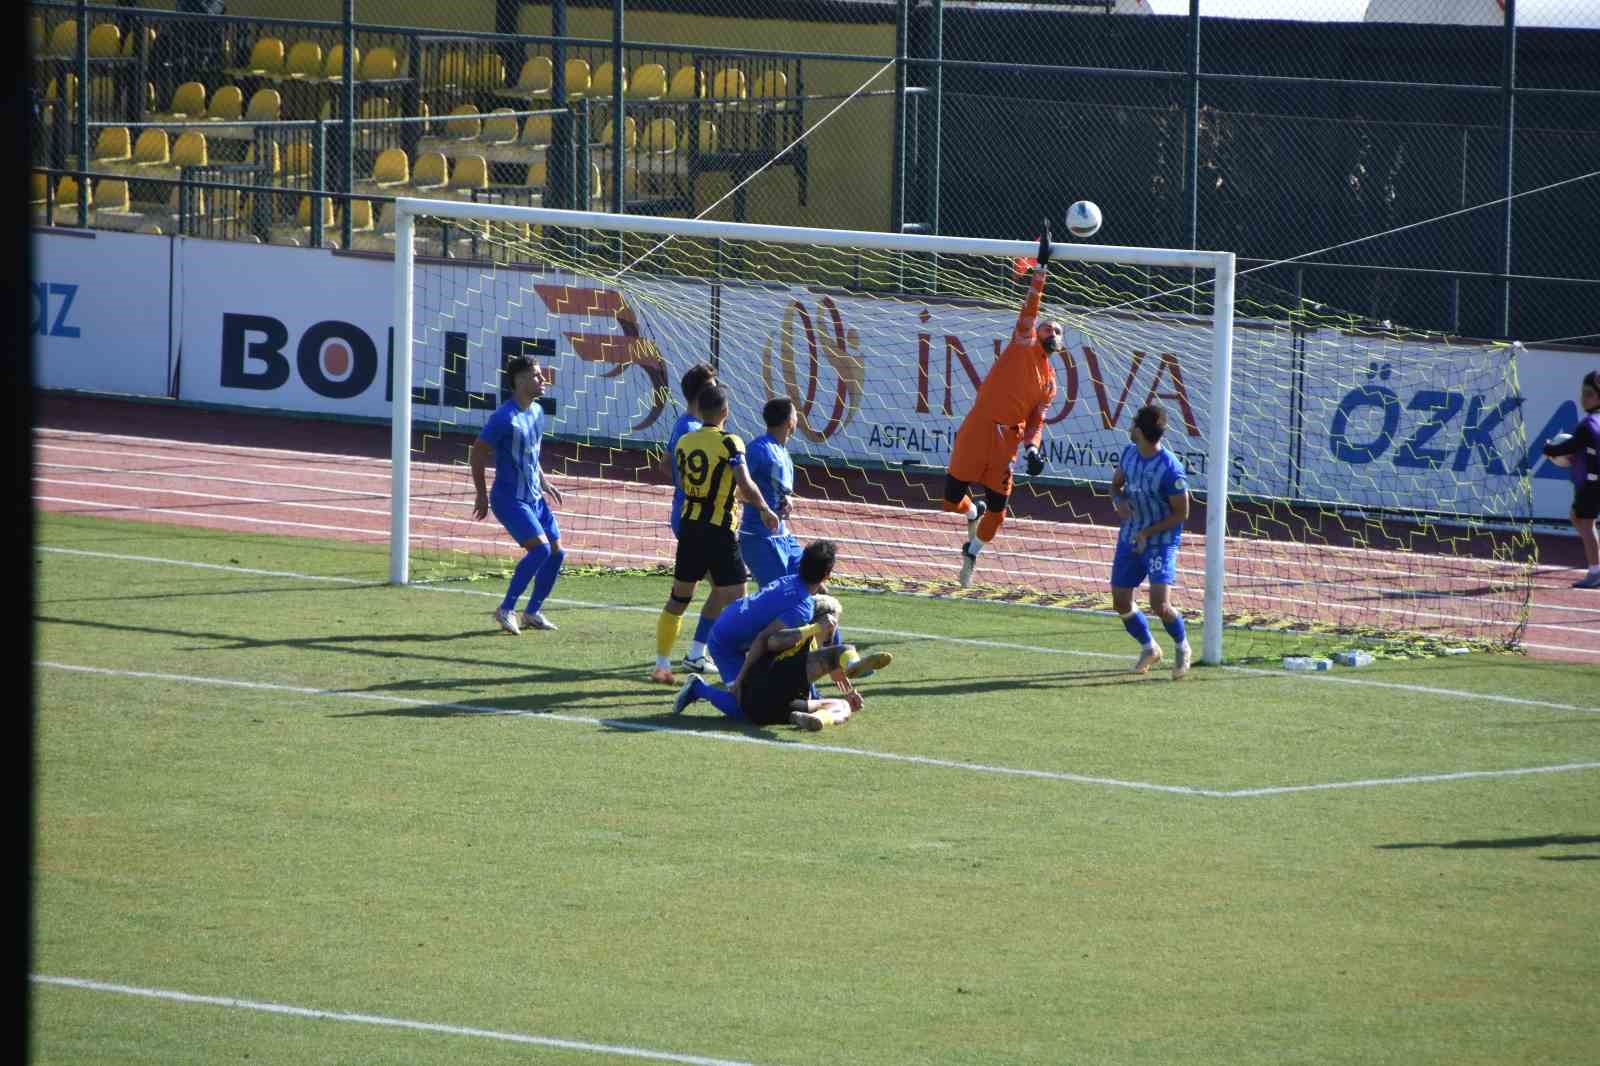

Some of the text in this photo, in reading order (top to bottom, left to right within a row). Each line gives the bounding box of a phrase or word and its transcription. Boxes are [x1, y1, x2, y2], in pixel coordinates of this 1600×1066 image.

[220, 312, 557, 416] BOLLE
[868, 424, 944, 452] ASFALT
[1024, 440, 1093, 468] ANAYİ
